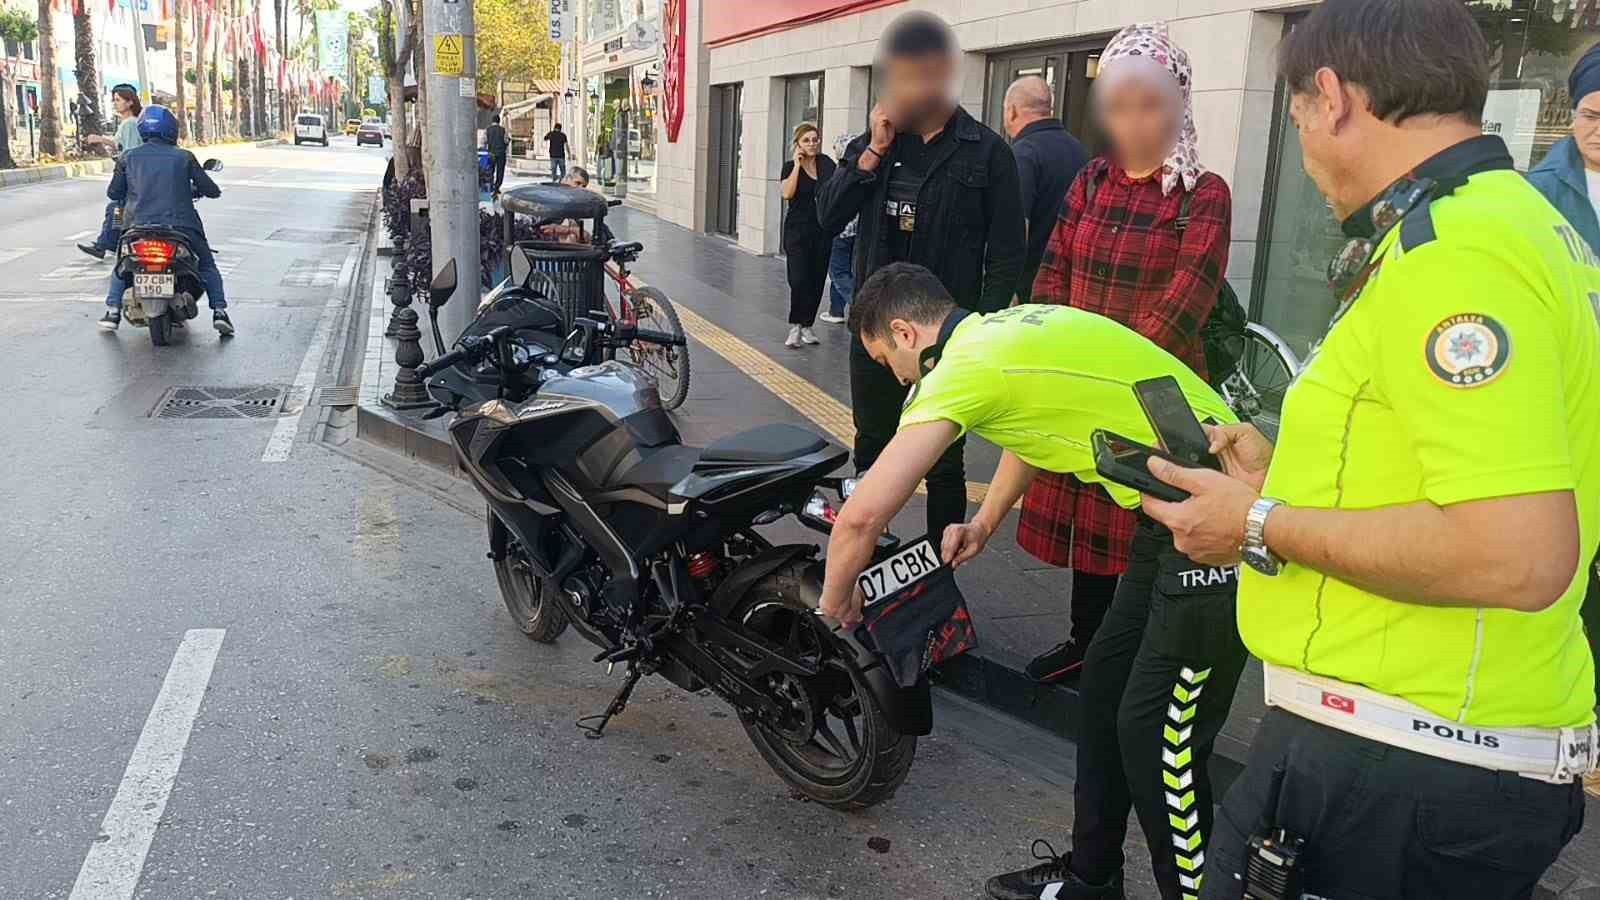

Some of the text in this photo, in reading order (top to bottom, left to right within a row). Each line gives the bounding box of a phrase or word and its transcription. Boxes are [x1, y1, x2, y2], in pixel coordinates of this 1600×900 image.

[136, 275, 149, 285] 07
[144, 285, 162, 295] 150
[858, 544, 936, 602] 07 CBK
[1412, 719, 1500, 748] POLİS
